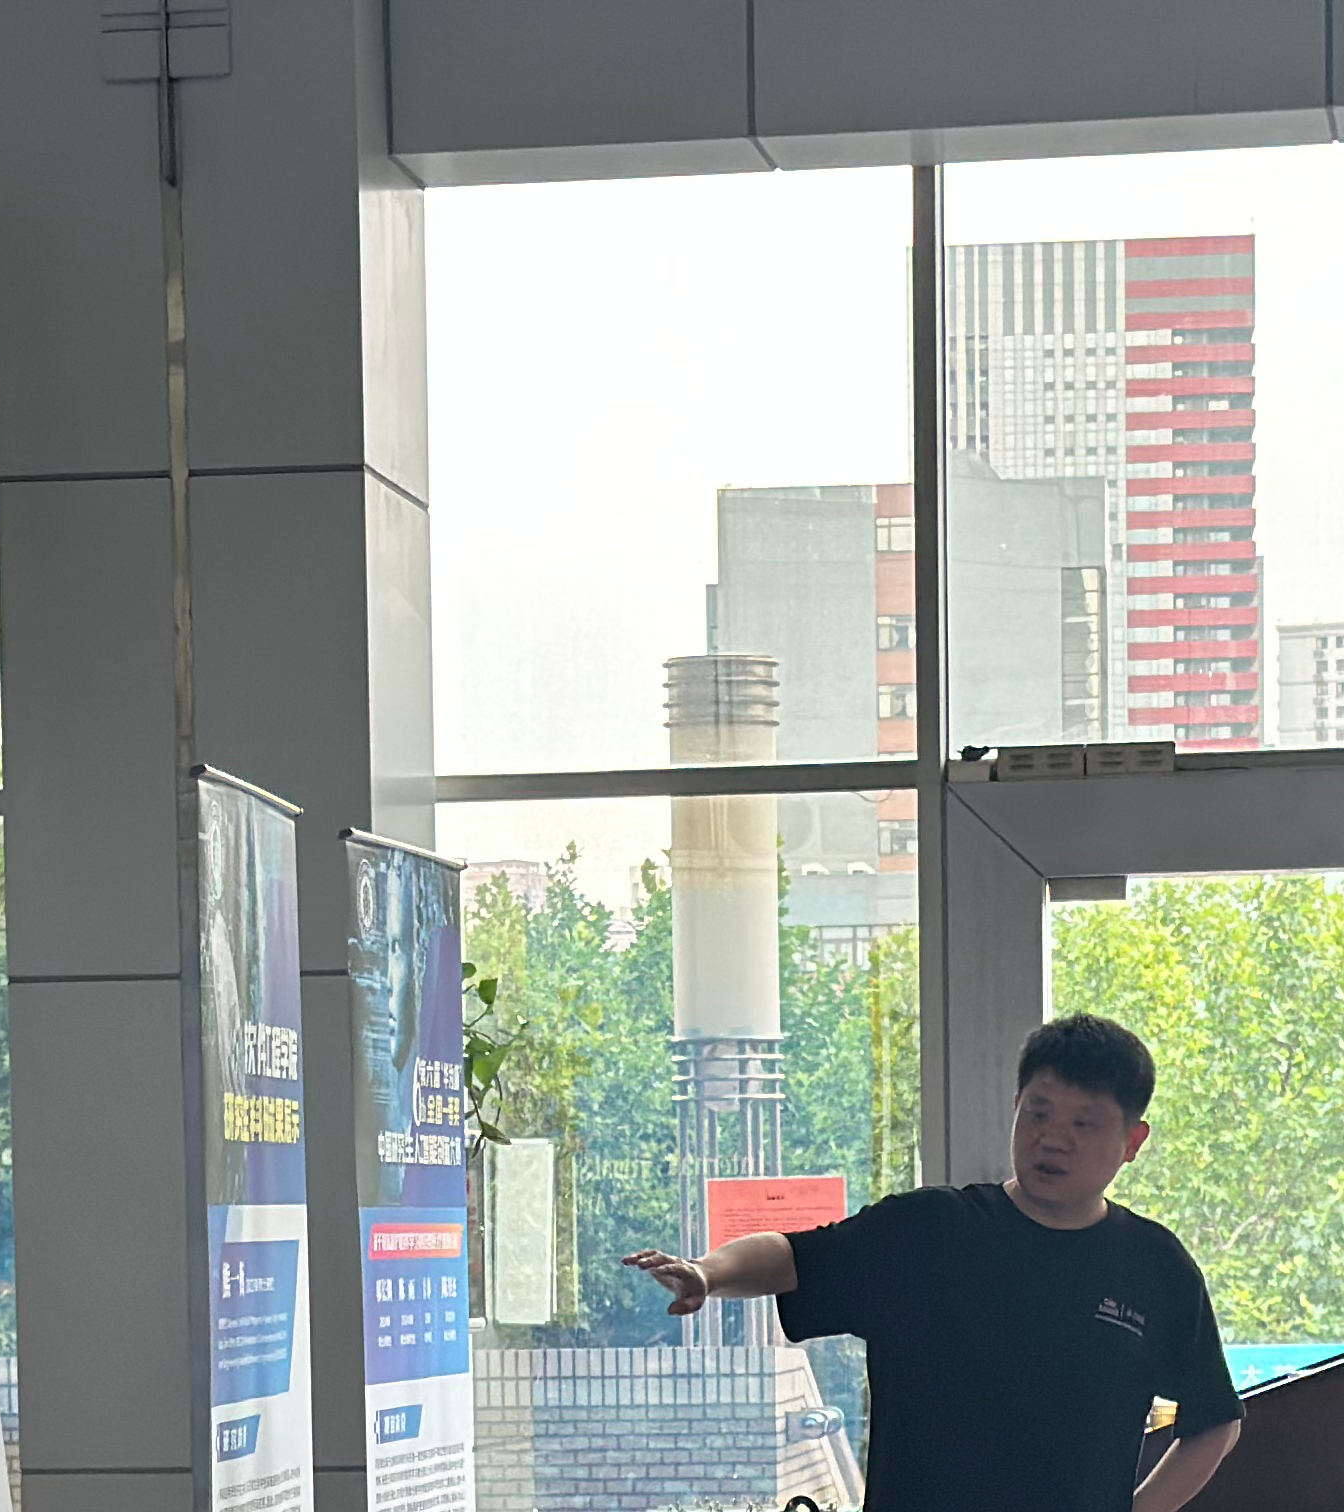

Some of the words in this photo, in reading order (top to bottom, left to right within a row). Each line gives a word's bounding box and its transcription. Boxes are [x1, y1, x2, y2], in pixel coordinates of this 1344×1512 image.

[244, 1021, 298, 1082] 软件工程学院
[223, 1092, 301, 1143] 研究生科研成果展示
